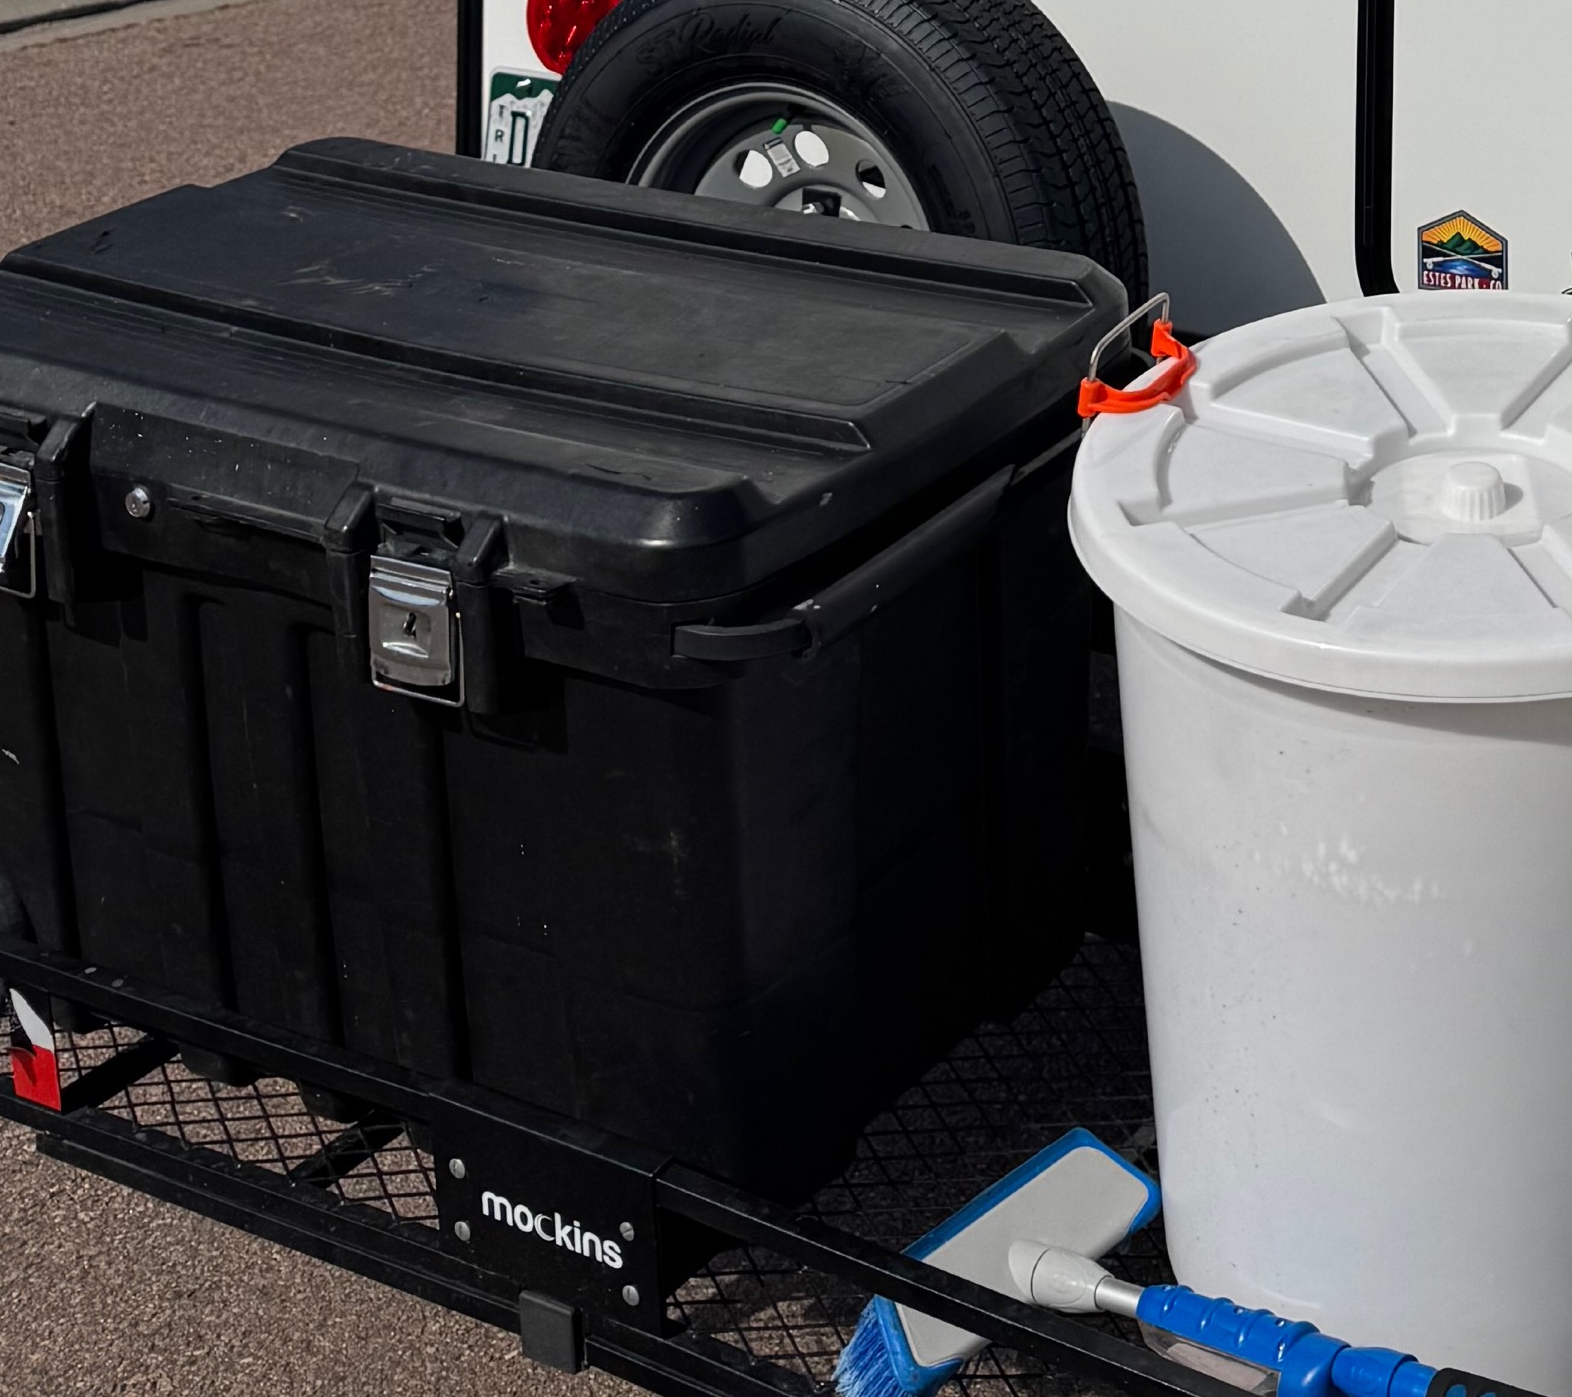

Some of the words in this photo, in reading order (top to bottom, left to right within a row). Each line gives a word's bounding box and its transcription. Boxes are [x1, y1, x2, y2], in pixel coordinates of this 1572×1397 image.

[1423, 270, 1451, 287] ESTES
[1455, 275, 1480, 289] PARK
[481, 1191, 623, 1269] mockins
